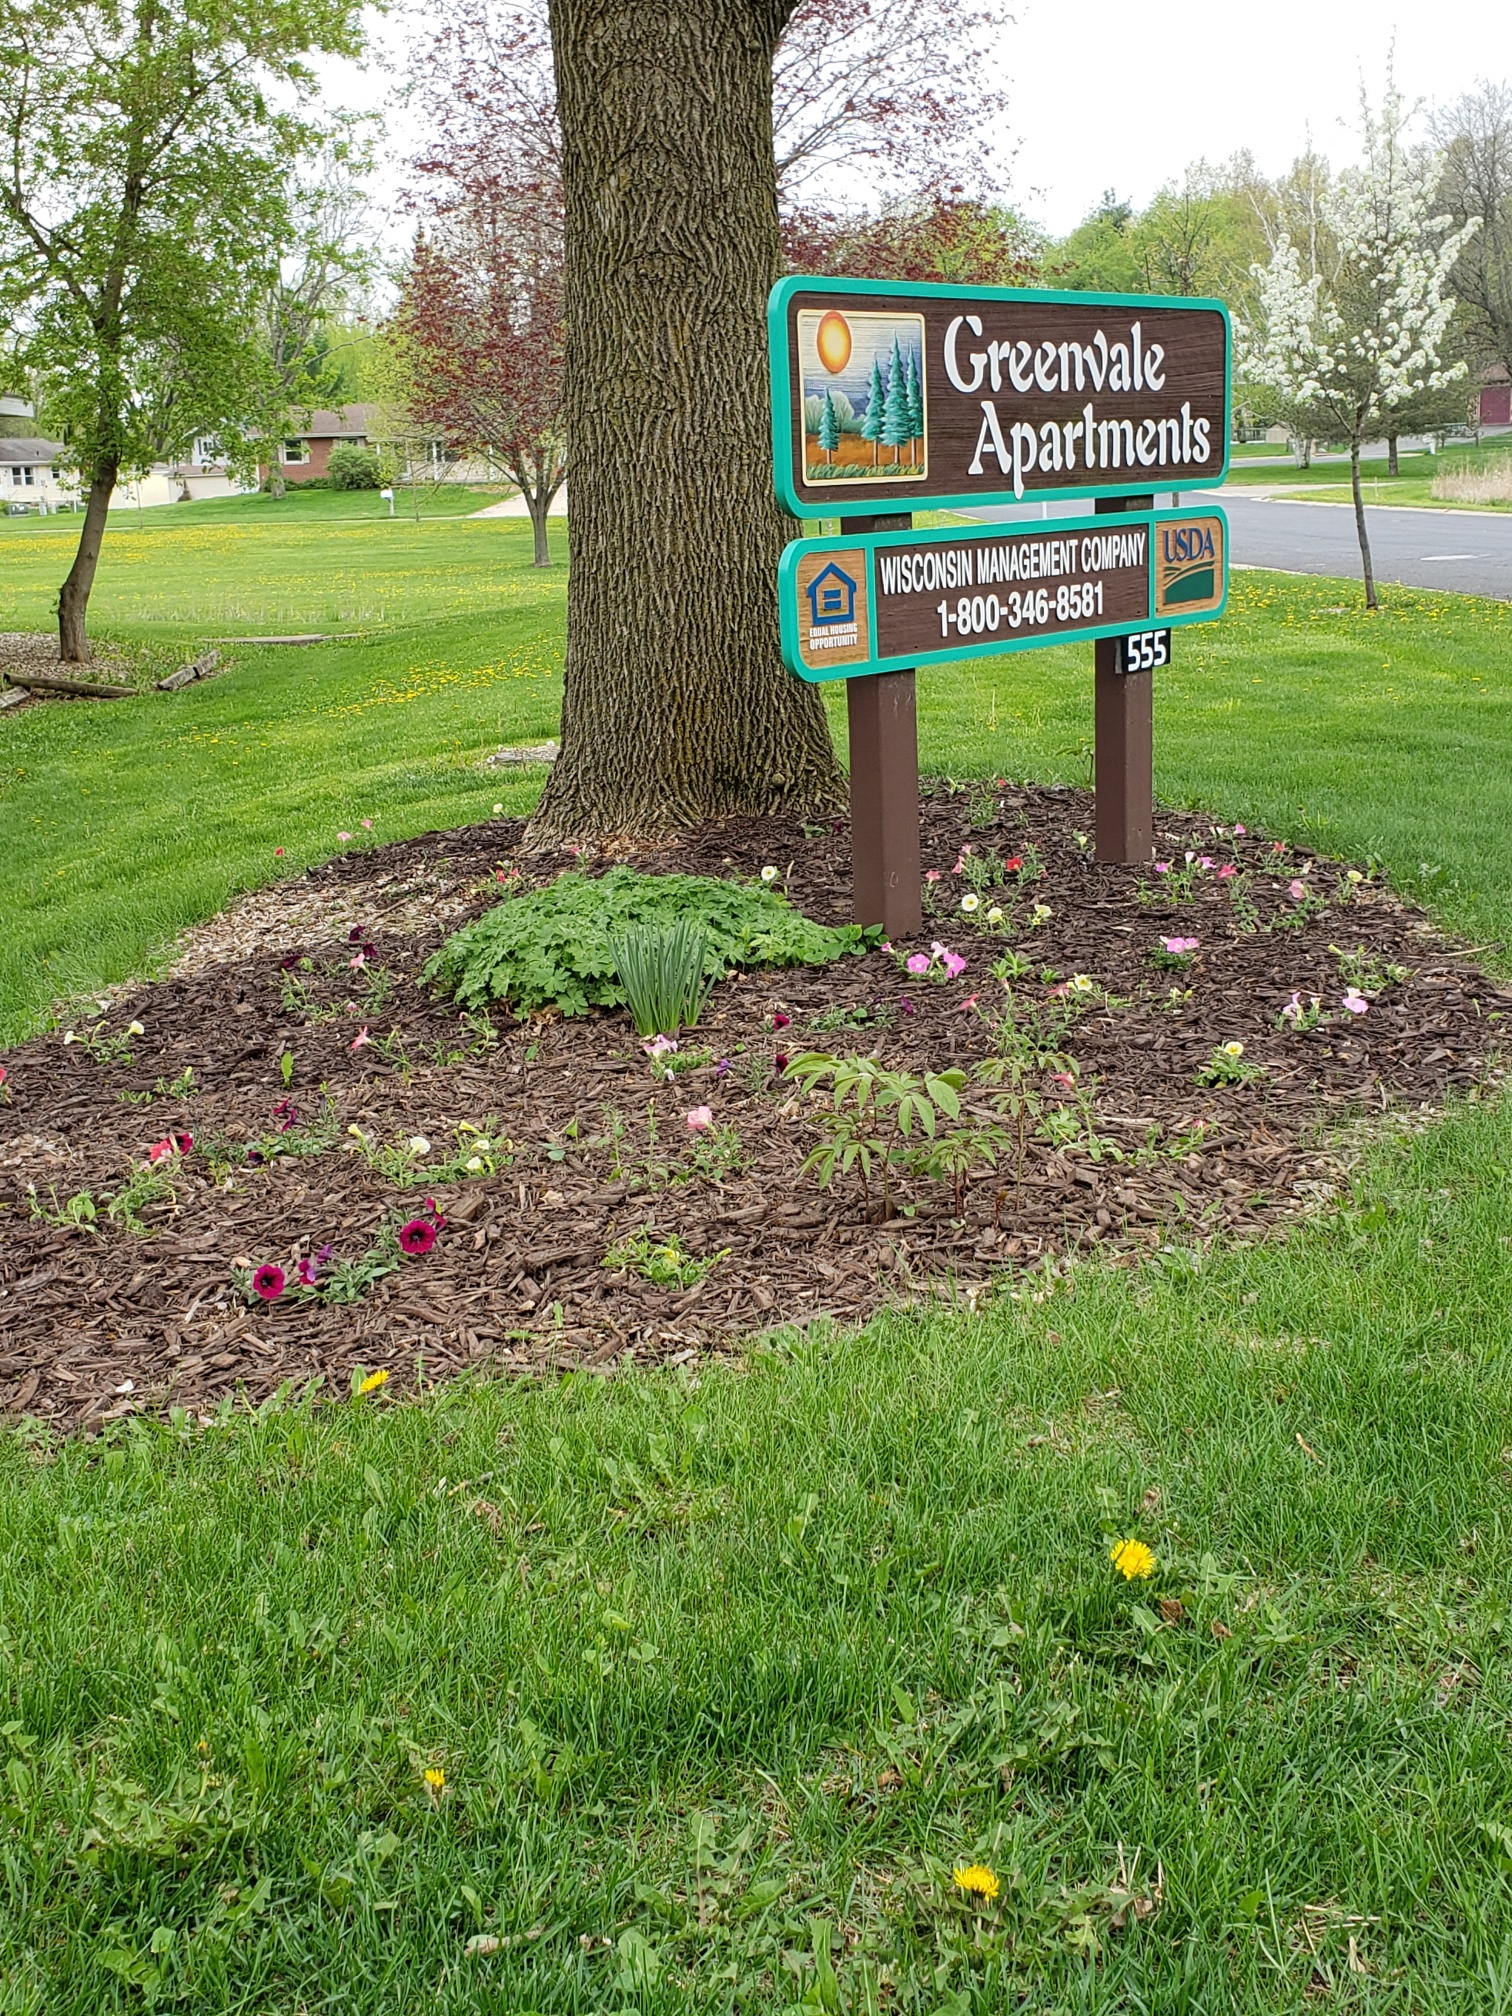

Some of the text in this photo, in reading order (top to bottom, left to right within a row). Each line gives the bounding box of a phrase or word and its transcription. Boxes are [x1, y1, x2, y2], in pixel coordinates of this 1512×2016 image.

[943, 315, 1166, 393] Greenvale
[967, 401, 1211, 499] Apartments
[880, 533, 1146, 595] WISCONSIN MANAGEMENT COMPANY
[1163, 527, 1215, 563] USDA
[809, 623, 857, 638] EQUAL HOUSING
[937, 581, 1103, 637] 1-800-346-8581
[809, 633, 857, 650] OPPORTUNITY
[1127, 631, 1166, 672] 555
